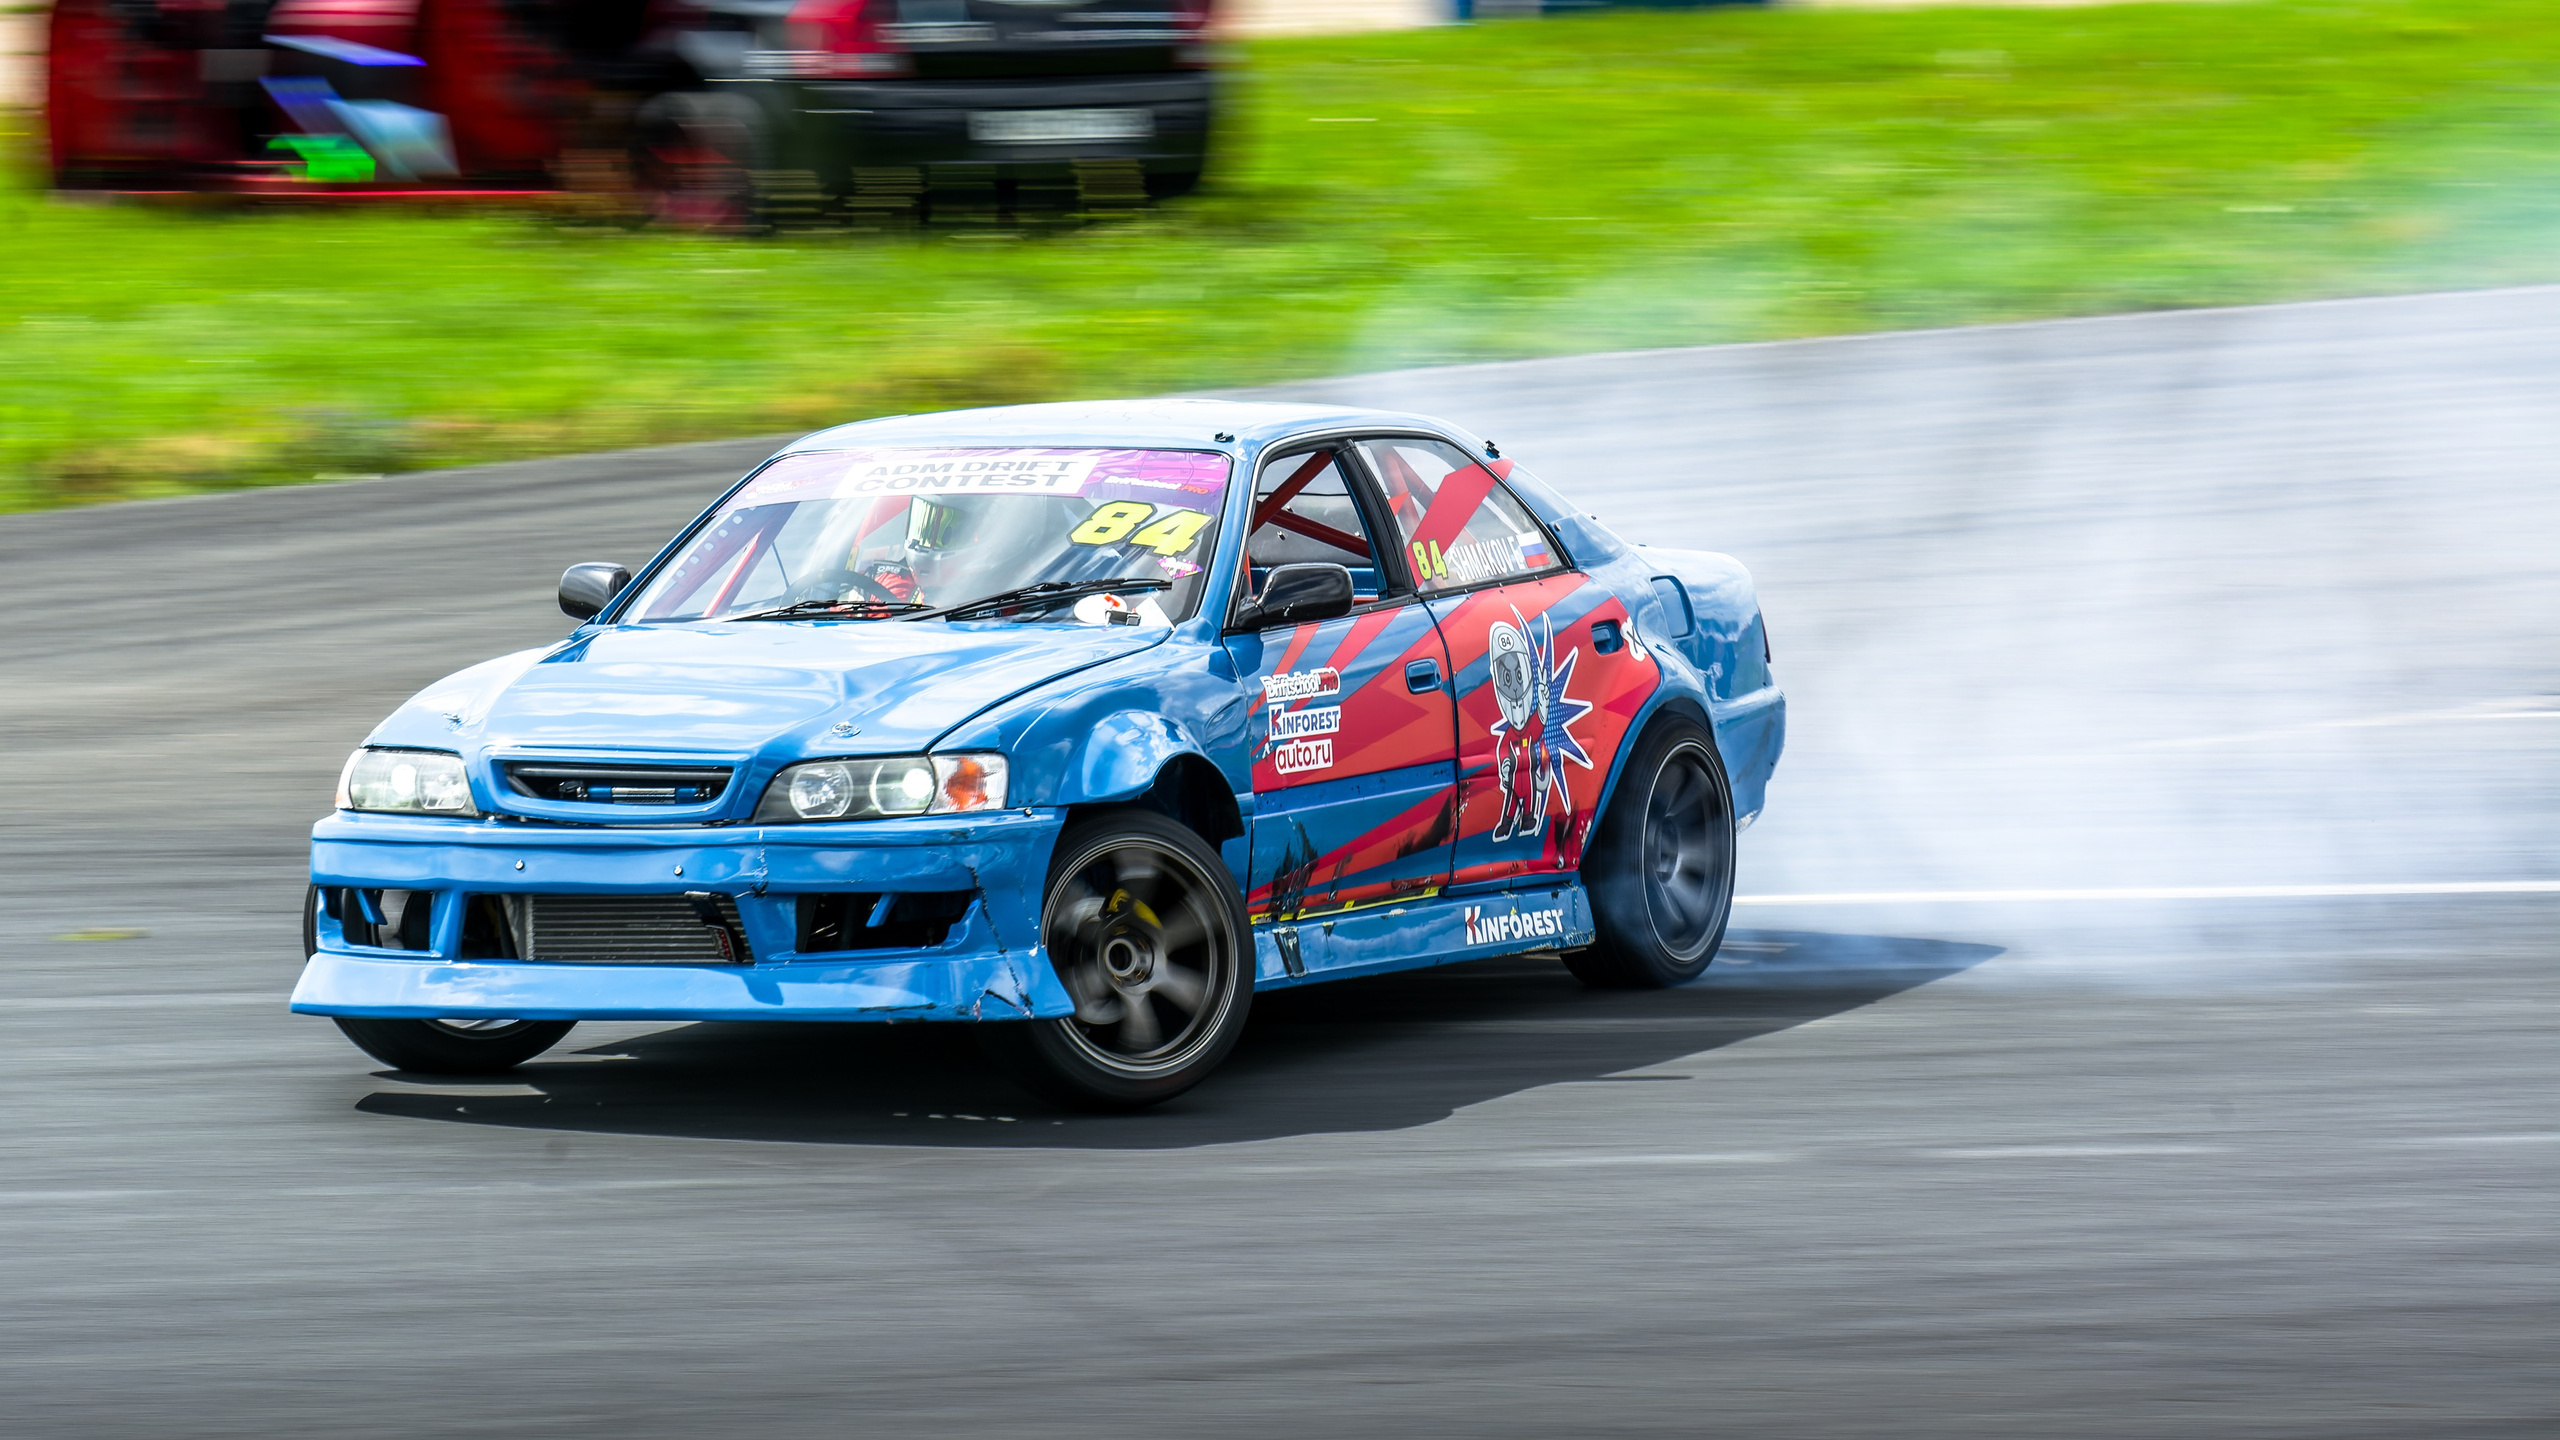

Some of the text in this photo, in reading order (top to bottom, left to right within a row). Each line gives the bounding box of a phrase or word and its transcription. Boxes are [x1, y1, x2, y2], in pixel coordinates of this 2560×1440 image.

[853, 473, 1070, 492] CONTEST
[864, 460, 1079, 477] ADM DRIFT
[1068, 500, 1215, 557] 84
[1411, 539, 1449, 580] 84
[1453, 538, 1515, 582] SHMAKOV
[1500, 636, 1512, 648] 84
[1270, 707, 1340, 737] KINFOREST
[1277, 742, 1331, 770] auto.ru
[1464, 905, 1564, 946] KINFOREST
